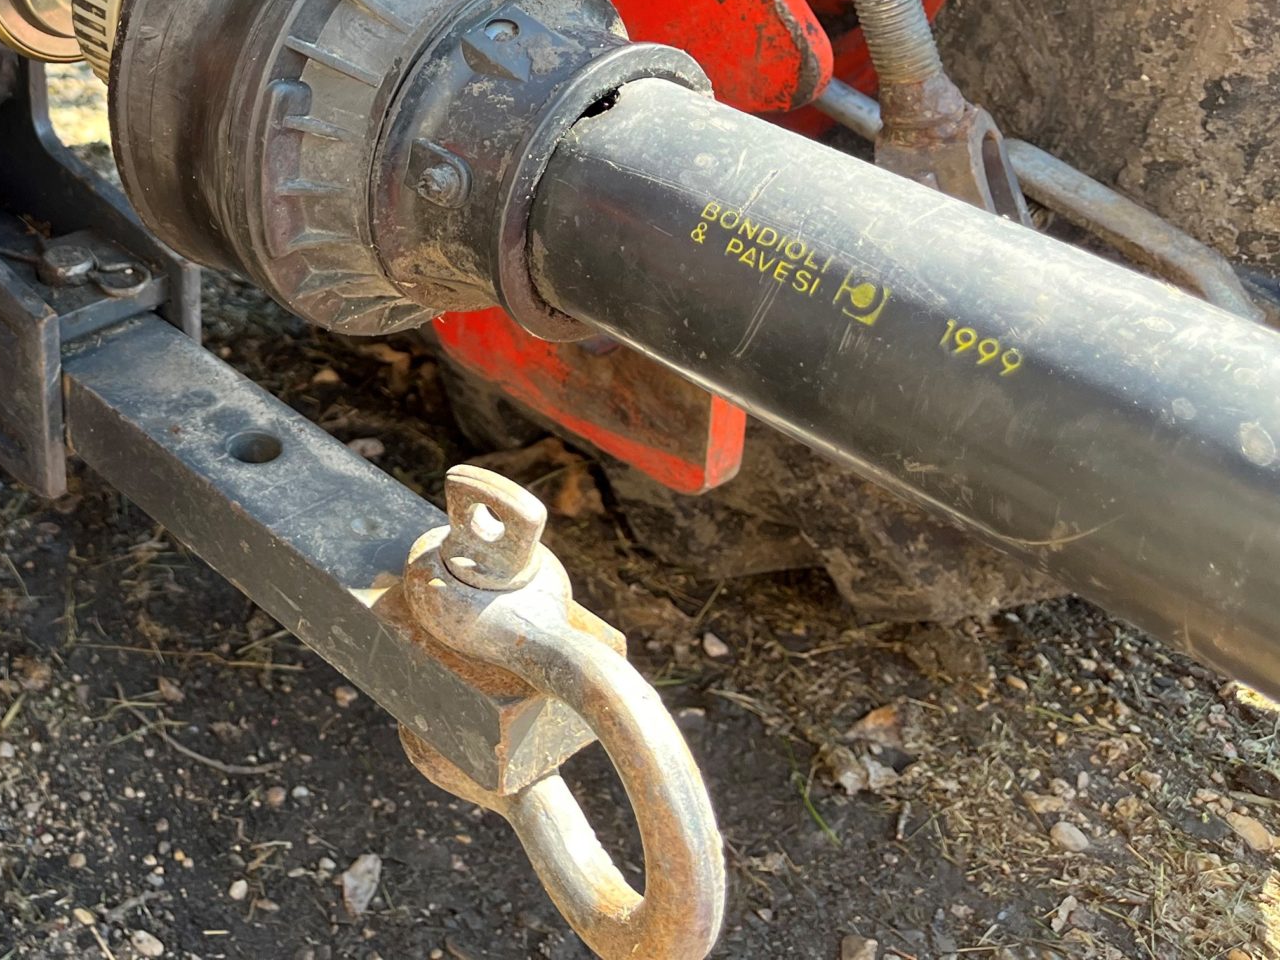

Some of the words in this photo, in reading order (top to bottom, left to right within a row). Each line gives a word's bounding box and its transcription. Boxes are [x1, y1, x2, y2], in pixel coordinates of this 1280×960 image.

[690, 221, 708, 244] &
[724, 237, 820, 297] PAVESI
[701, 201, 835, 273] BONDIOLI
[939, 319, 1023, 376] 1999
